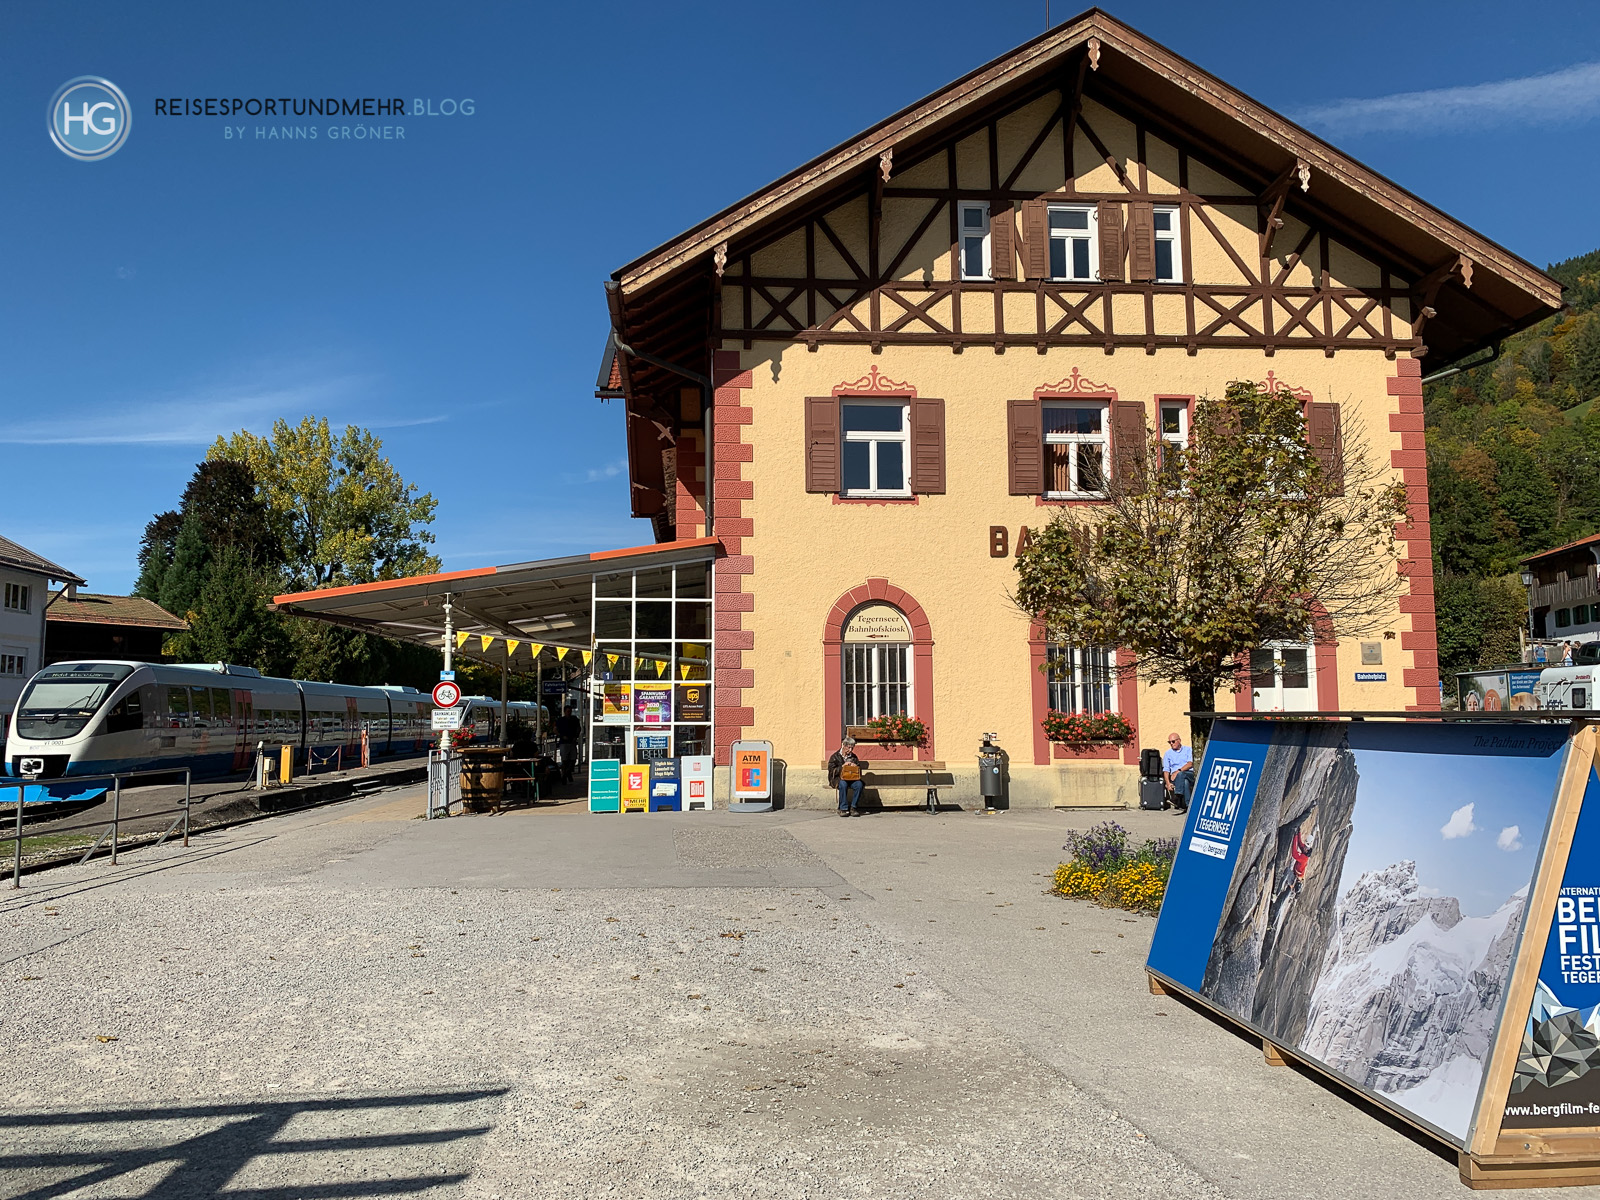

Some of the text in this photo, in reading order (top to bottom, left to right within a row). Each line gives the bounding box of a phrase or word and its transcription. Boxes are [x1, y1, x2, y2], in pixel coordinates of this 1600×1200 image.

[856, 615, 900, 625] Tegernseer
[848, 625, 906, 633] Bahnhofskiosk
[605, 672, 611, 680] 1
[1473, 735, 1490, 748] The
[1490, 736, 1525, 750] Pathan
[629, 773, 642, 789] tz
[1210, 765, 1246, 792] BERG
[1202, 789, 1239, 822] FILM
[1199, 817, 1231, 835] TEGERNSEE
[1560, 887, 1600, 896] NTERNATI
[1557, 897, 1600, 923] BE
[1559, 924, 1600, 955] FIL
